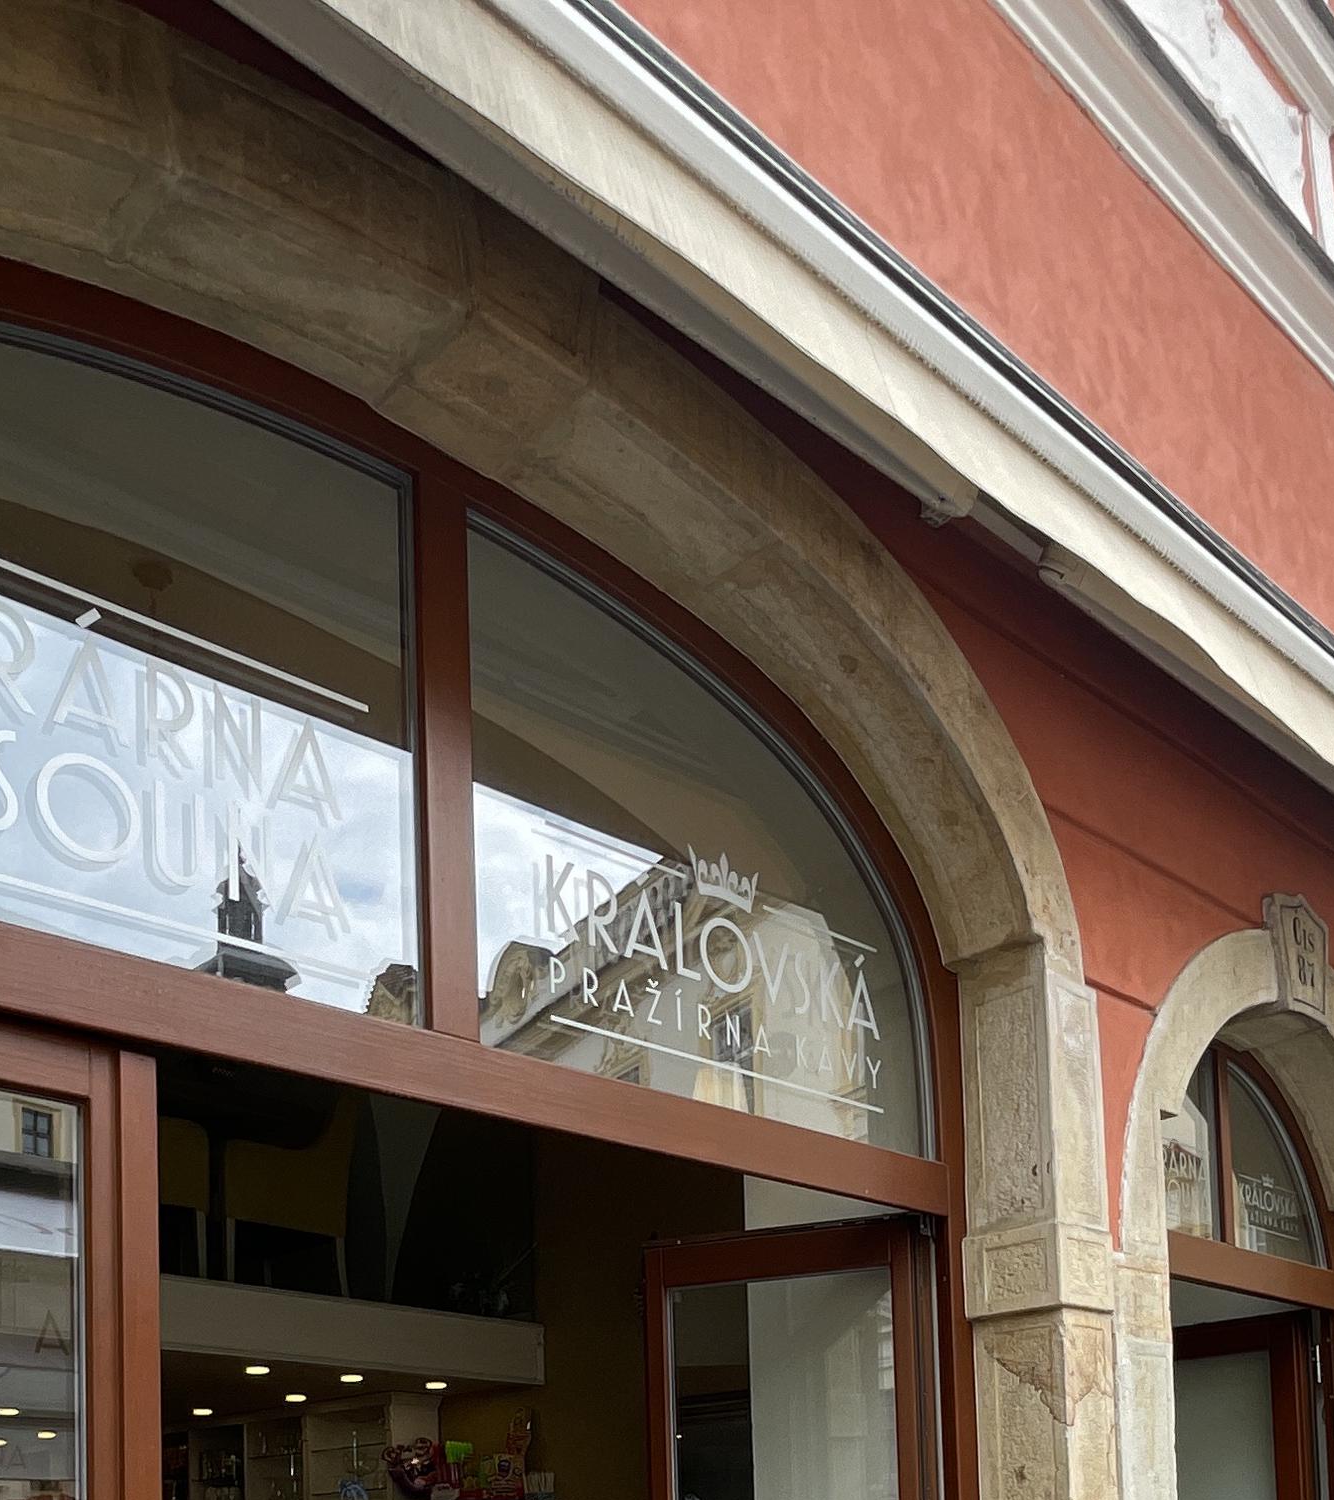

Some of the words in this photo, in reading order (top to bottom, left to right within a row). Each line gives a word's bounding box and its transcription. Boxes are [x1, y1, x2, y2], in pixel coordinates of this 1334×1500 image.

[545, 853, 881, 1041] KRÁLOVSKÁ
[1297, 955, 1316, 988] 87
[548, 956, 772, 1057] PRAŽÍRNA
[796, 1034, 882, 1089] KÁVY
